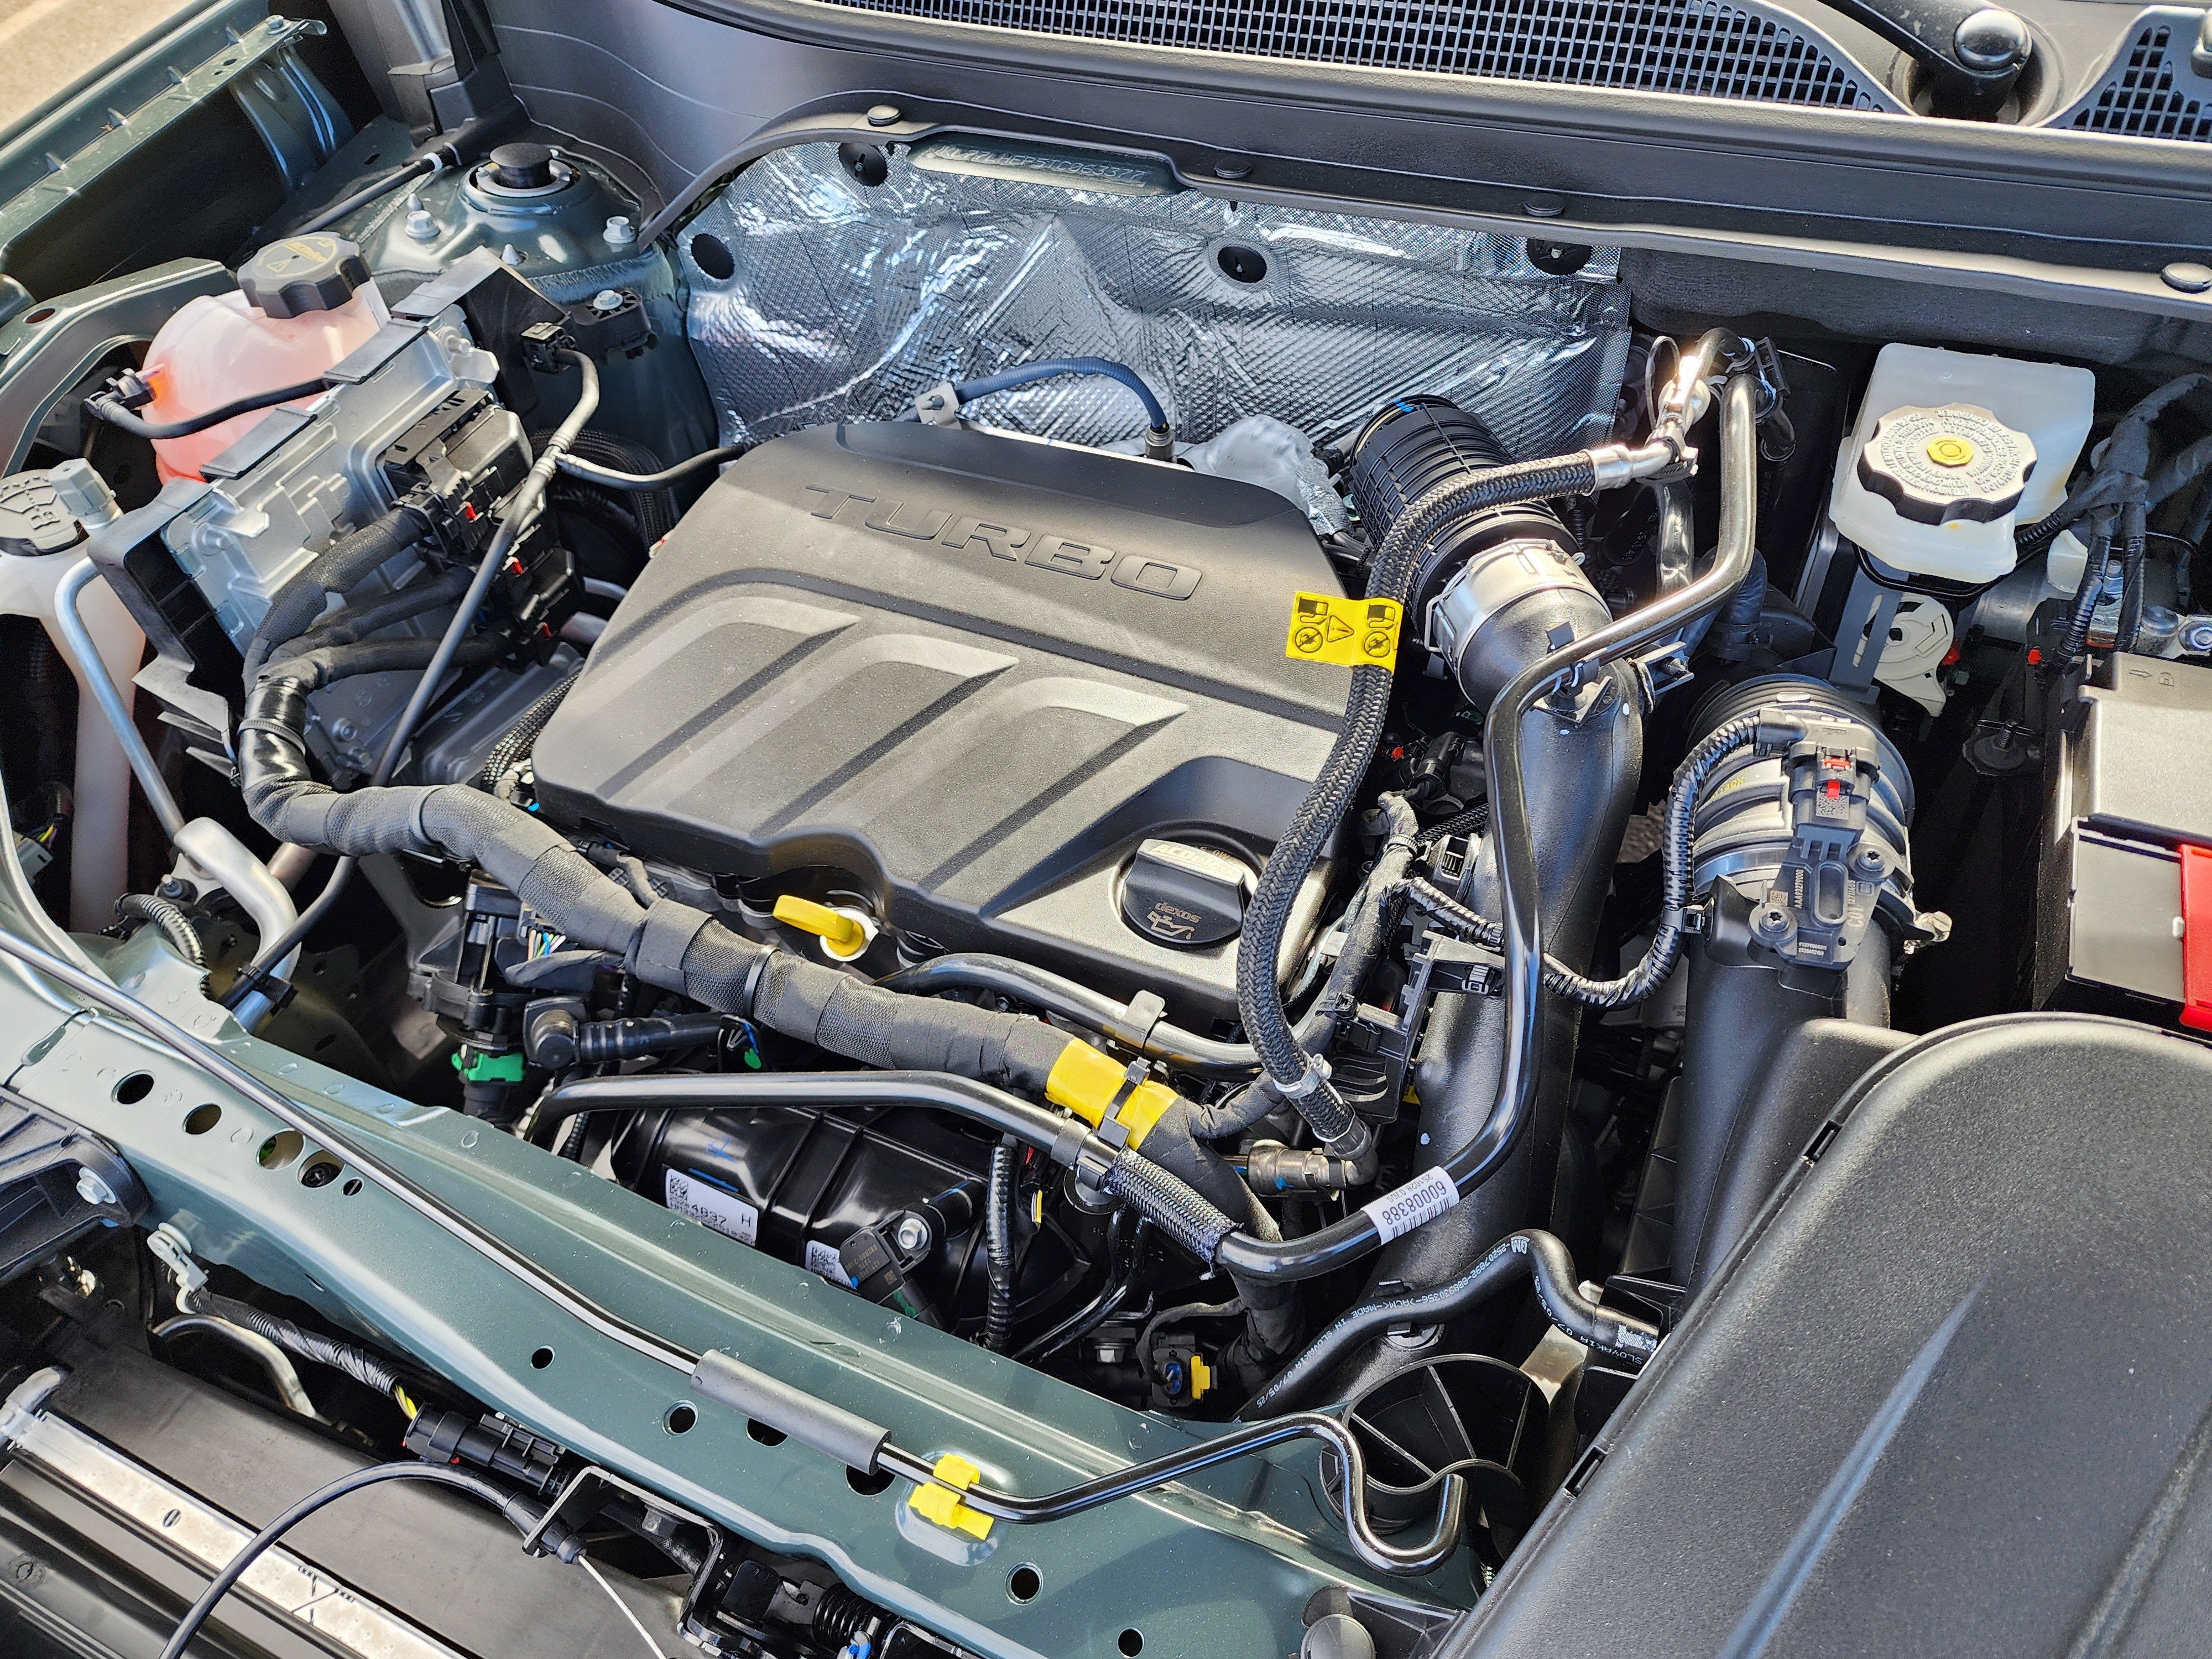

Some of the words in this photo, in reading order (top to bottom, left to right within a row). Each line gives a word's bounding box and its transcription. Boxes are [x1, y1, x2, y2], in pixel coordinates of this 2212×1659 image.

[805, 485, 1203, 601] TURBO
[1149, 844, 1234, 875] ACDelco
[1794, 869, 1804, 909] AAA93279000
[1155, 902, 1202, 924] dexos
[1386, 1188, 1406, 1202] 0709
[1405, 1173, 1433, 1192] 251028
[1382, 1181, 1447, 1225] 60008388
[1511, 1238, 1529, 1254] GM
[1334, 1318, 1347, 1331] IN
[1295, 1329, 1333, 1369] SLOVAKIA
[1579, 1335, 1644, 1365] SLOVAKIA
[1256, 1370, 1293, 1408] 07/05/25
